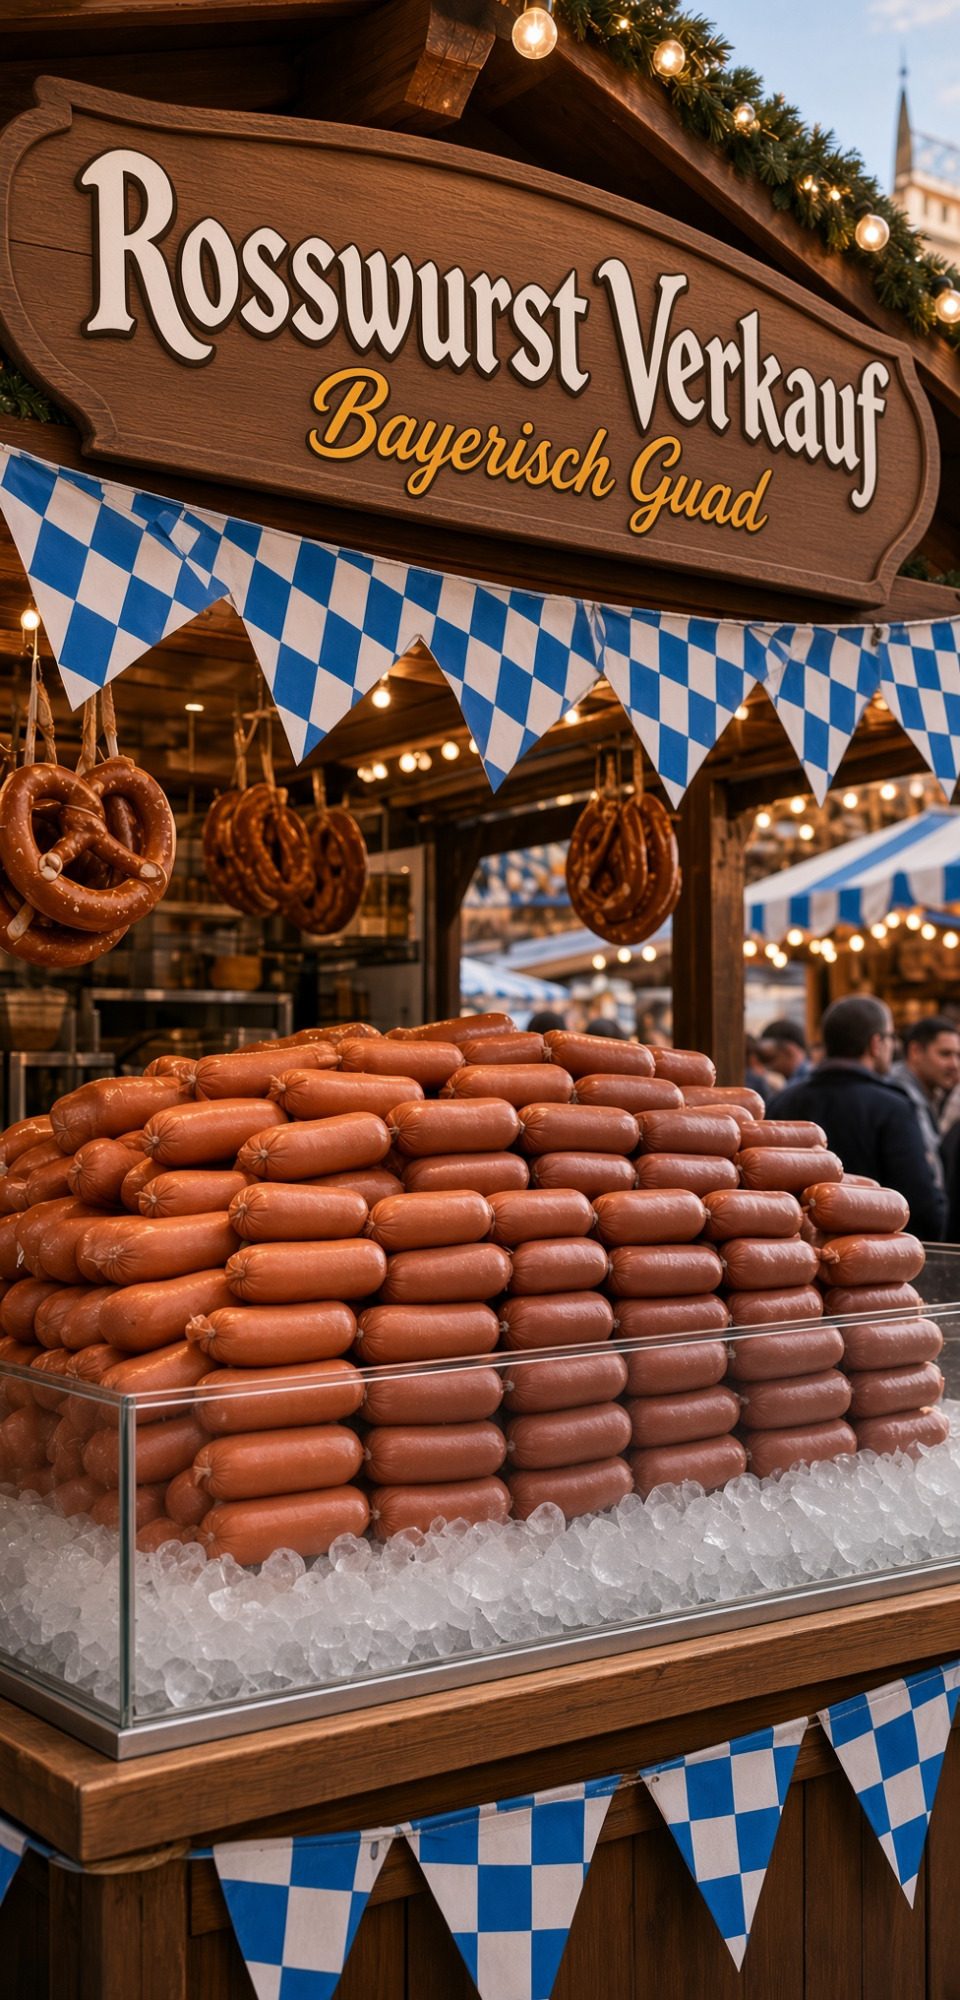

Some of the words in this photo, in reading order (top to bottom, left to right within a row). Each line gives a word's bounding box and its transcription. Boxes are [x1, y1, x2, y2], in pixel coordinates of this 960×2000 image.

[81, 149, 589, 392] Rosswurst
[597, 259, 889, 508] Verkauf
[309, 367, 616, 497] Bayerisch
[629, 435, 772, 533] Guad
